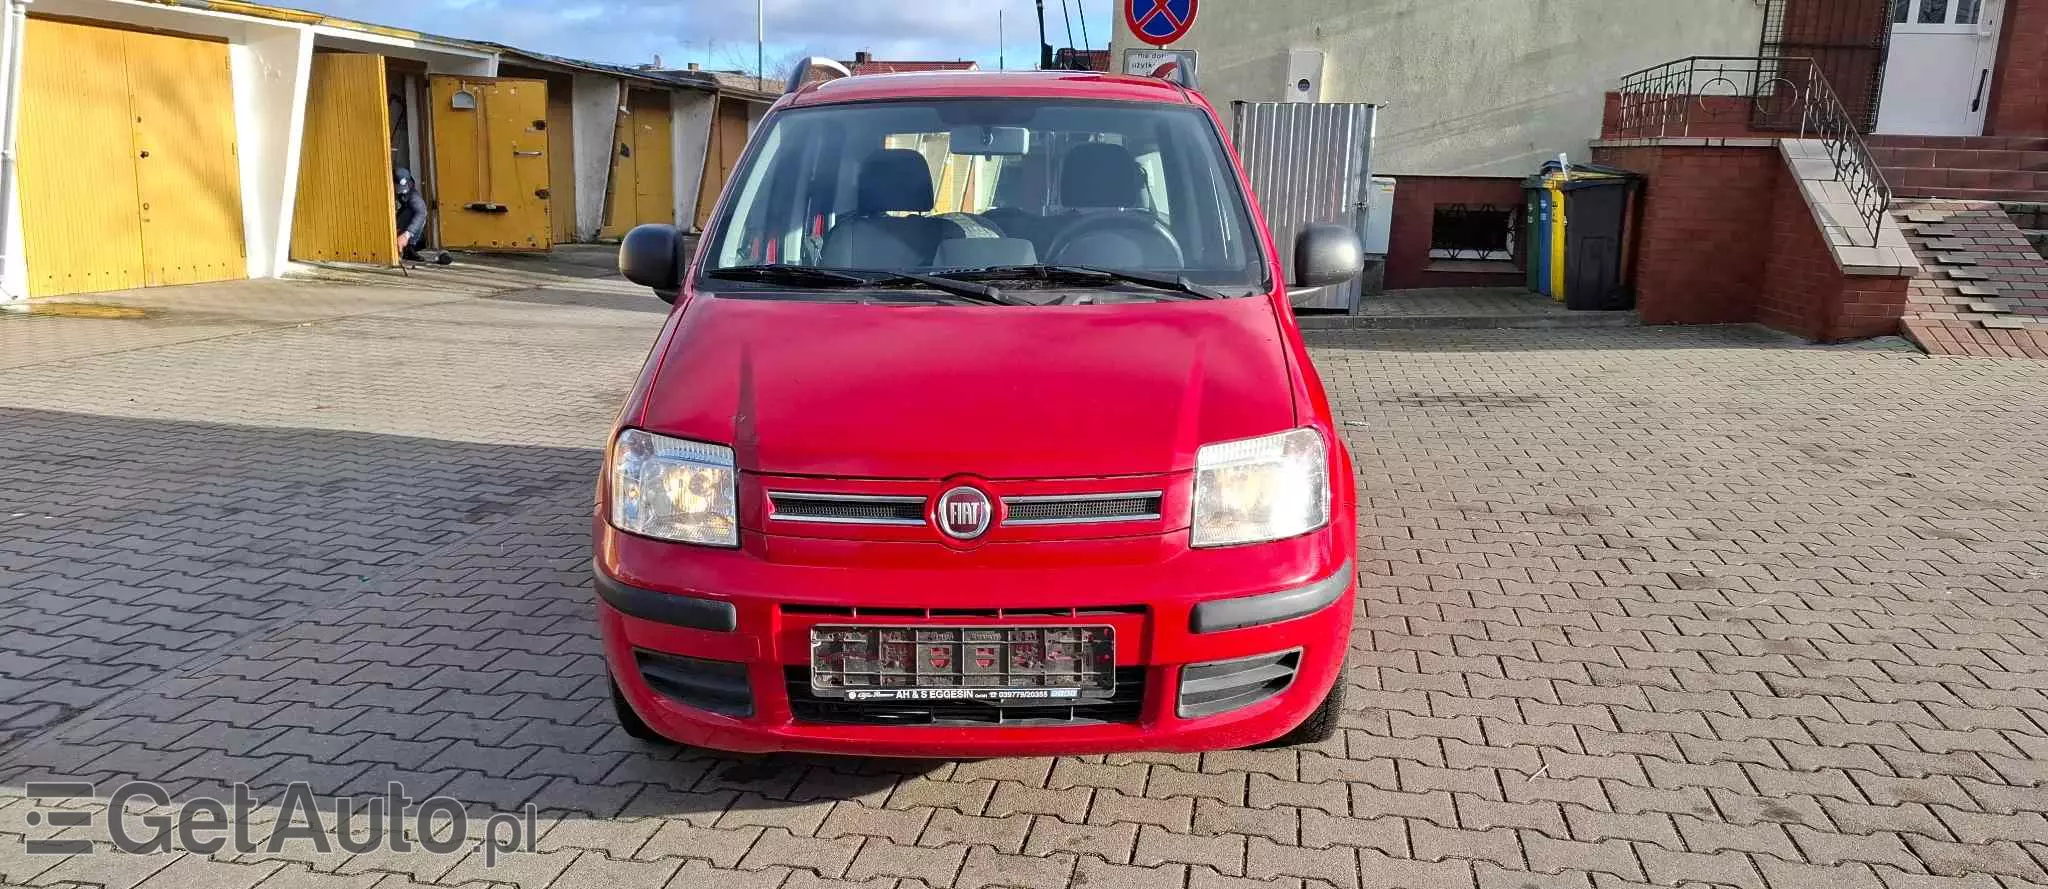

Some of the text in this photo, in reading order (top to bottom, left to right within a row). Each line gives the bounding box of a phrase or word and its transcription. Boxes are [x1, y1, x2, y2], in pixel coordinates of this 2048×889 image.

[950, 501, 980, 525] FIAT
[896, 690, 910, 699] AH
[920, 690, 928, 699] S
[929, 690, 974, 699] EGGESIN
